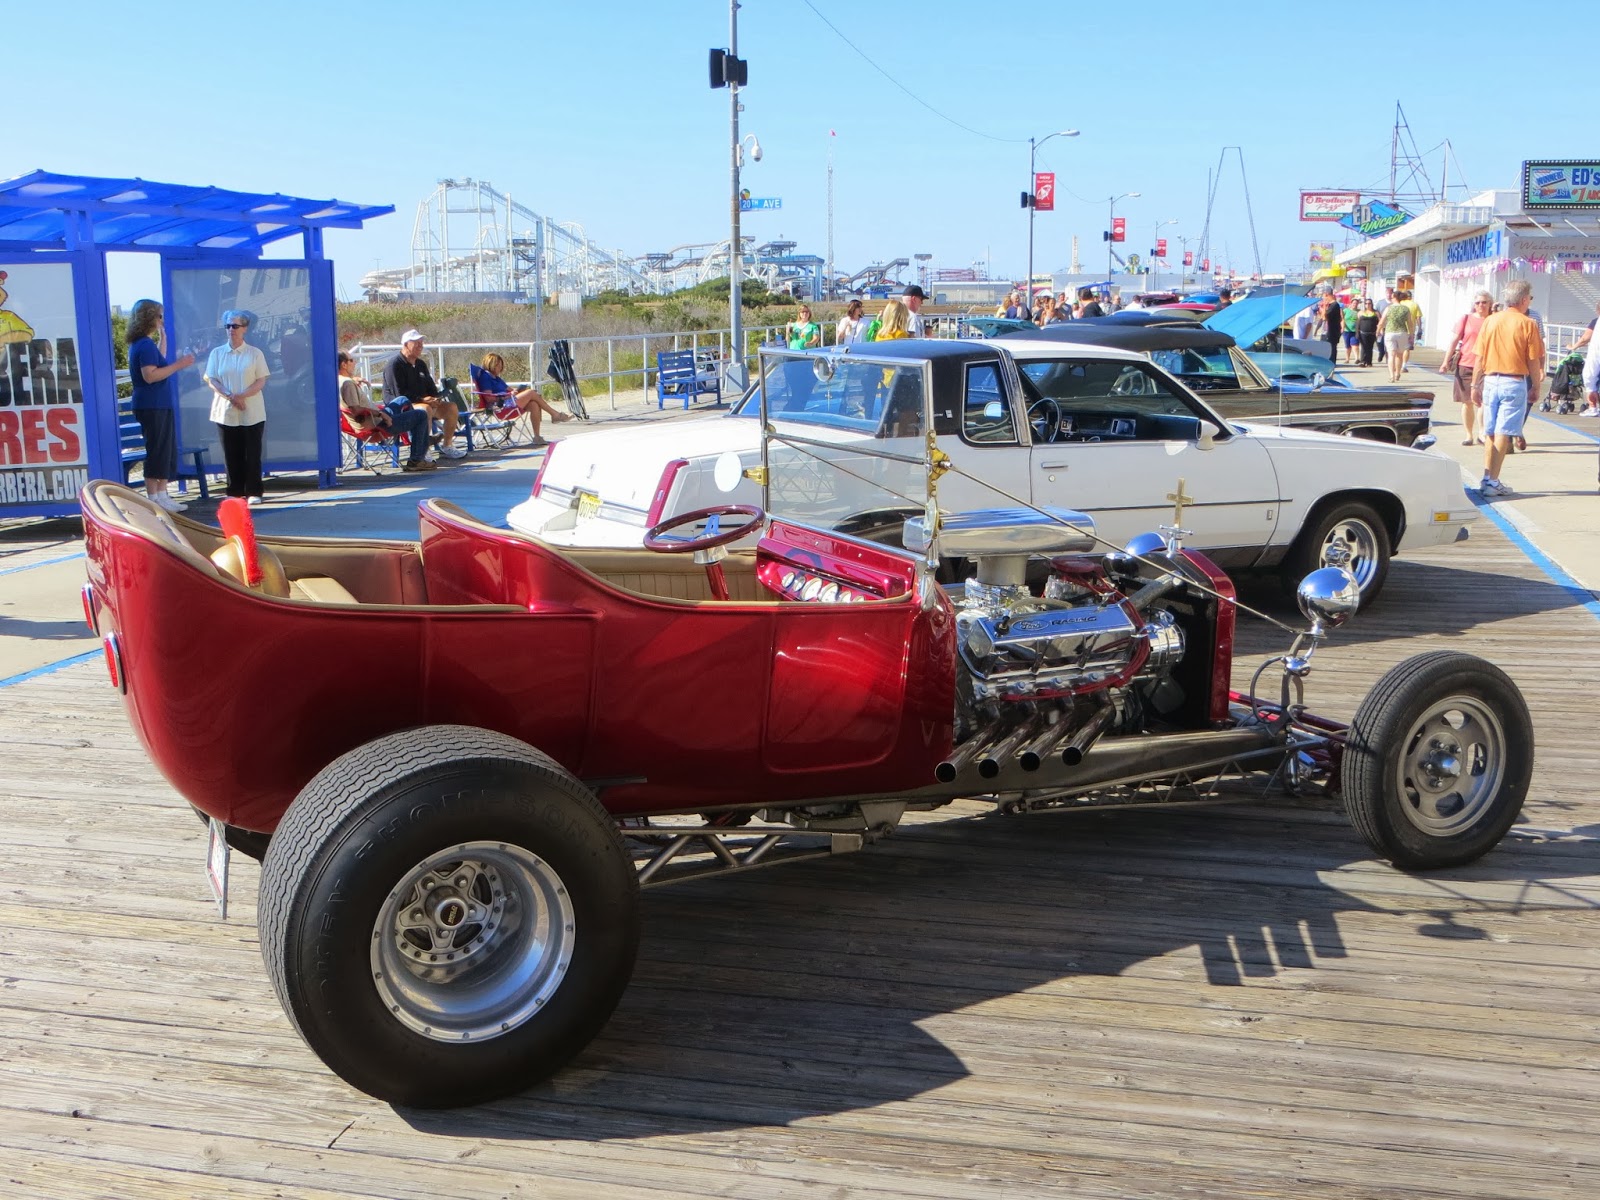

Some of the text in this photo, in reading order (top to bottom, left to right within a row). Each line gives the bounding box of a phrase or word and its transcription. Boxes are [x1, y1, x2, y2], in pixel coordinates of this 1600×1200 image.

[763, 199, 780, 208] AVE
[1359, 211, 1407, 233] FUNCADE
[1514, 240, 1576, 251] Welcome
[1051, 616, 1097, 626] RACING
